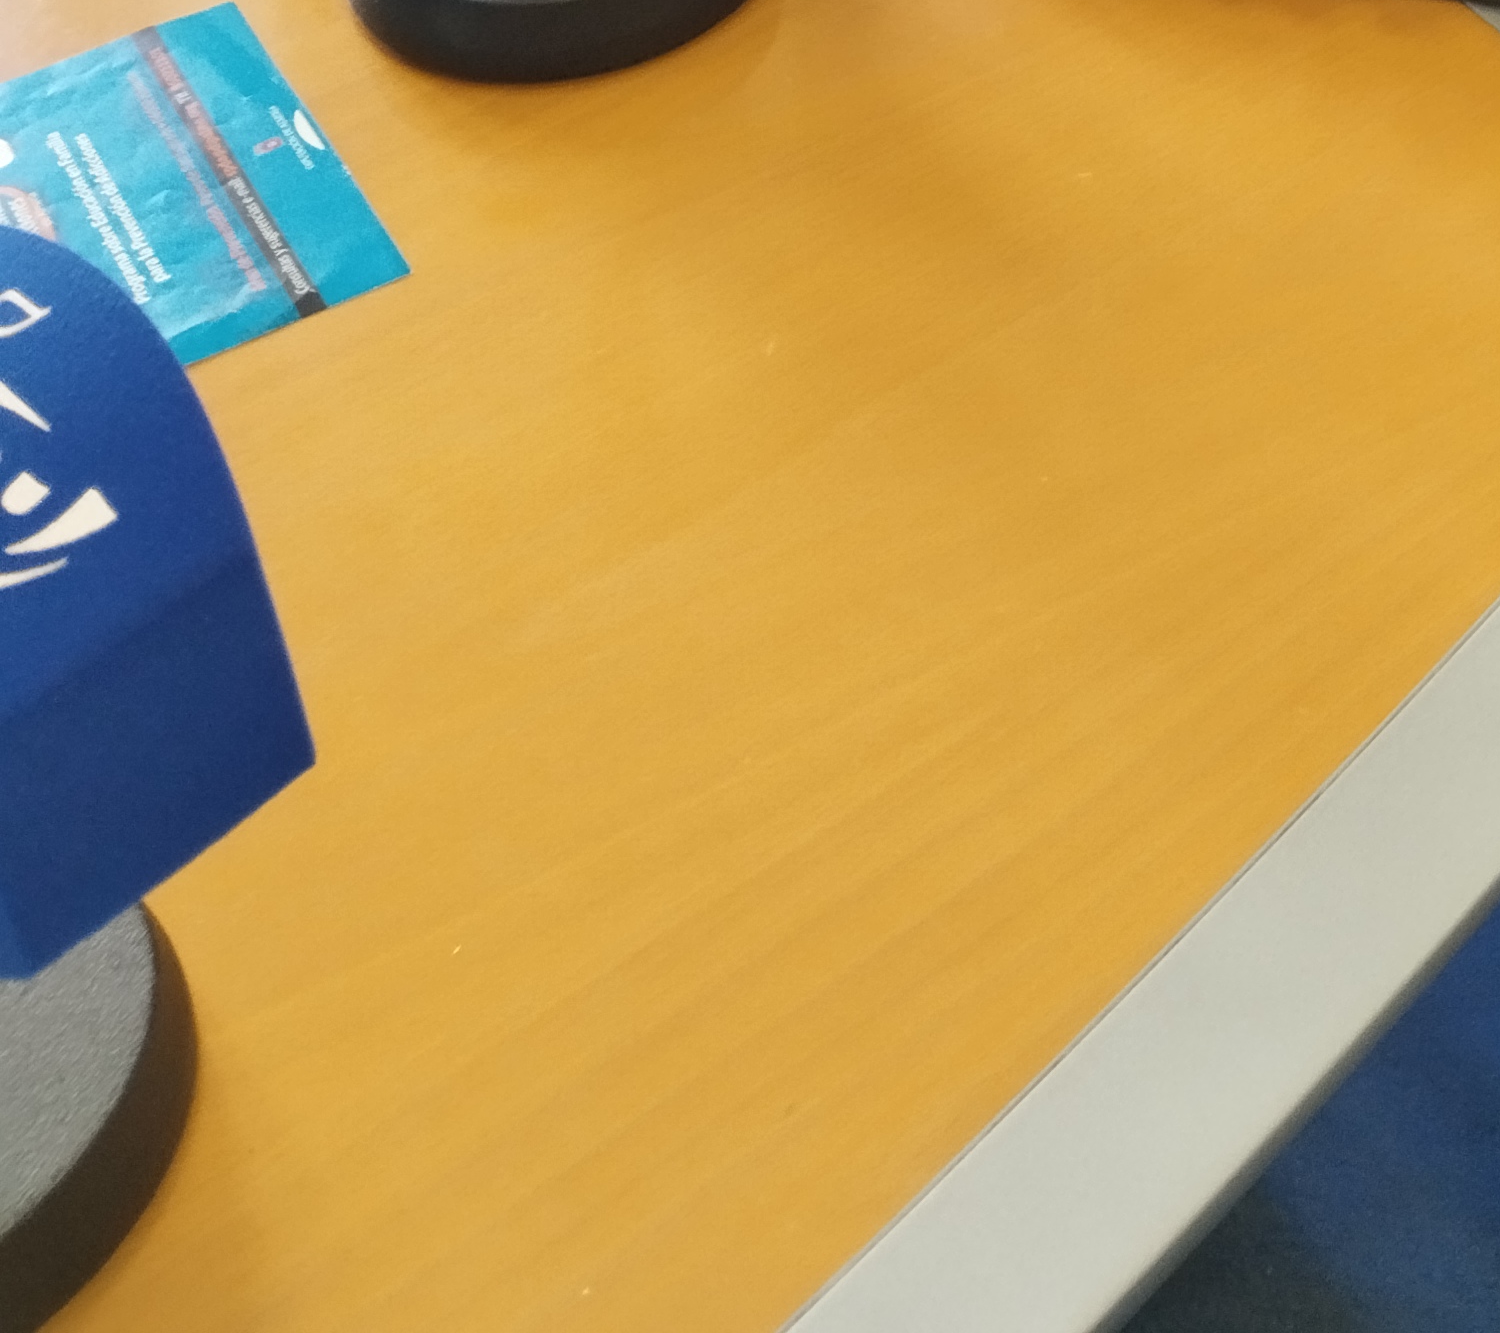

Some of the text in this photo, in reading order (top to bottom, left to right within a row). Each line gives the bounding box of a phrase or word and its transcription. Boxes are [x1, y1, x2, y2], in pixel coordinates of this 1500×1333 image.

[45, 130, 151, 303] Programa sobre Educación en Familia
[73, 132, 171, 281] para la Prevención de Adicciones
[272, 248, 290, 258] y
[277, 254, 310, 293] Consultas
